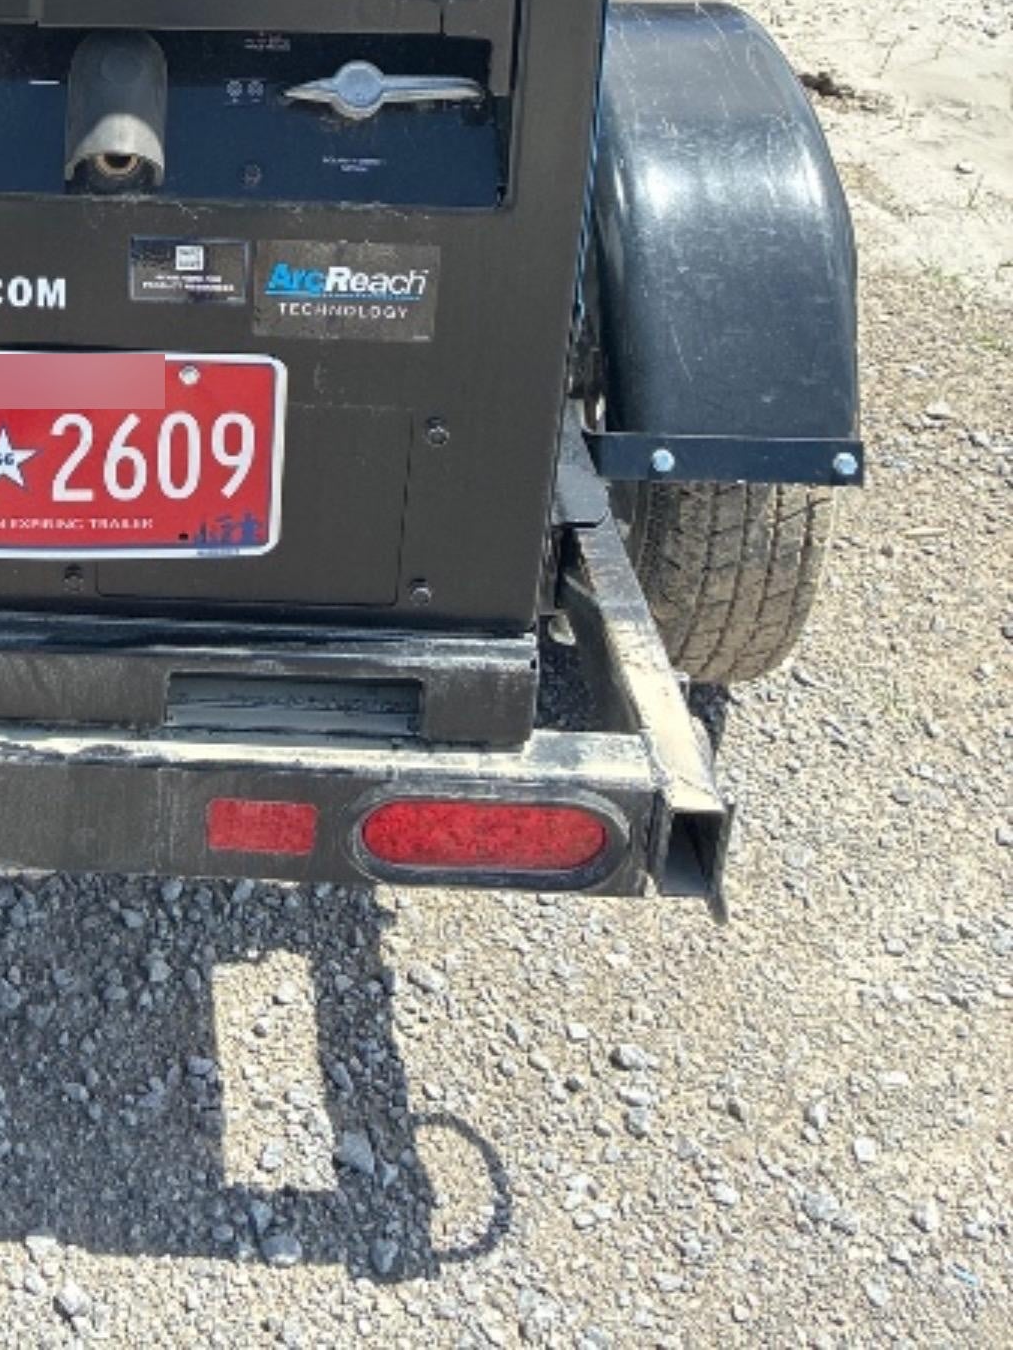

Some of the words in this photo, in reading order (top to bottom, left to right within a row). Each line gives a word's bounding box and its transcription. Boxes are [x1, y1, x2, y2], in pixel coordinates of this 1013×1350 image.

[266, 262, 426, 295] ArcReach
[279, 302, 408, 319] TECHNOLOGY
[49, 412, 256, 502] 2609
[89, 517, 155, 530] TRAILER
